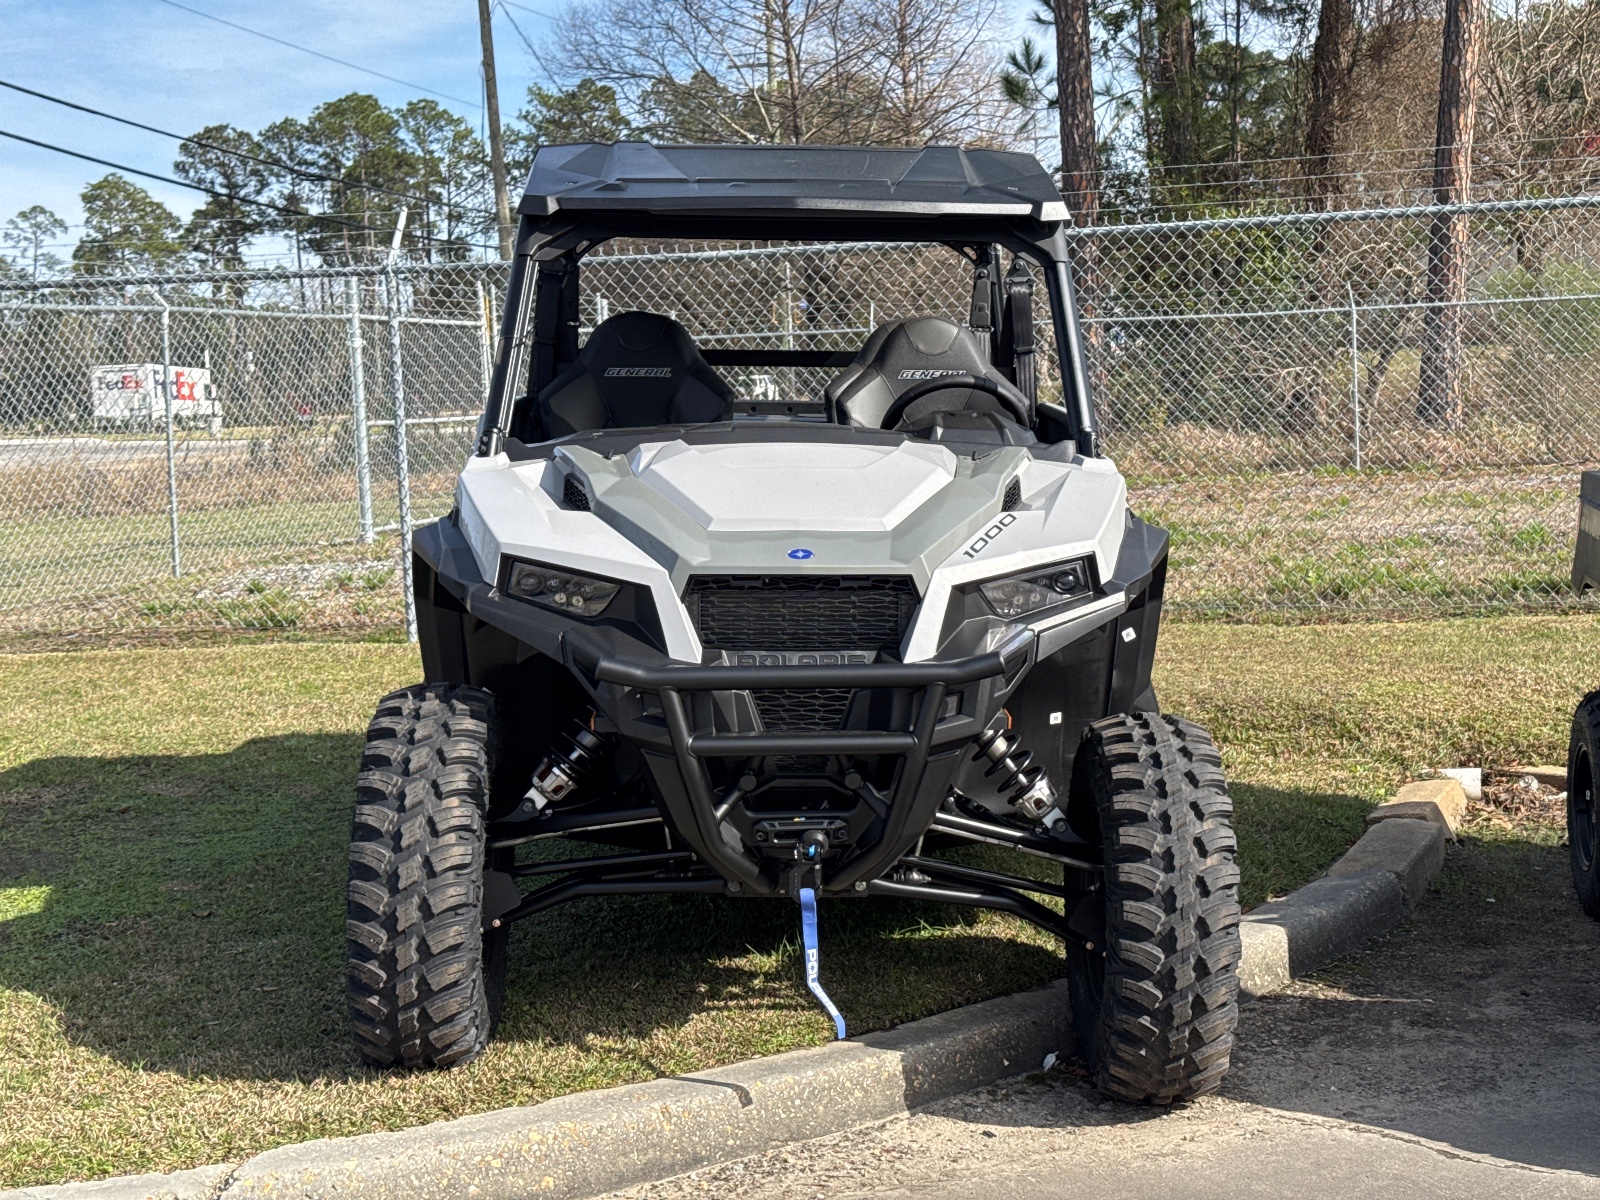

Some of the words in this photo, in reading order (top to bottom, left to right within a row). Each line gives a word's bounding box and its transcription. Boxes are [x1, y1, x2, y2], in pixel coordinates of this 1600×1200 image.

[604, 367, 672, 378] GENERAL
[963, 513, 1017, 559] 1000
[736, 654, 867, 666] POLARIS
